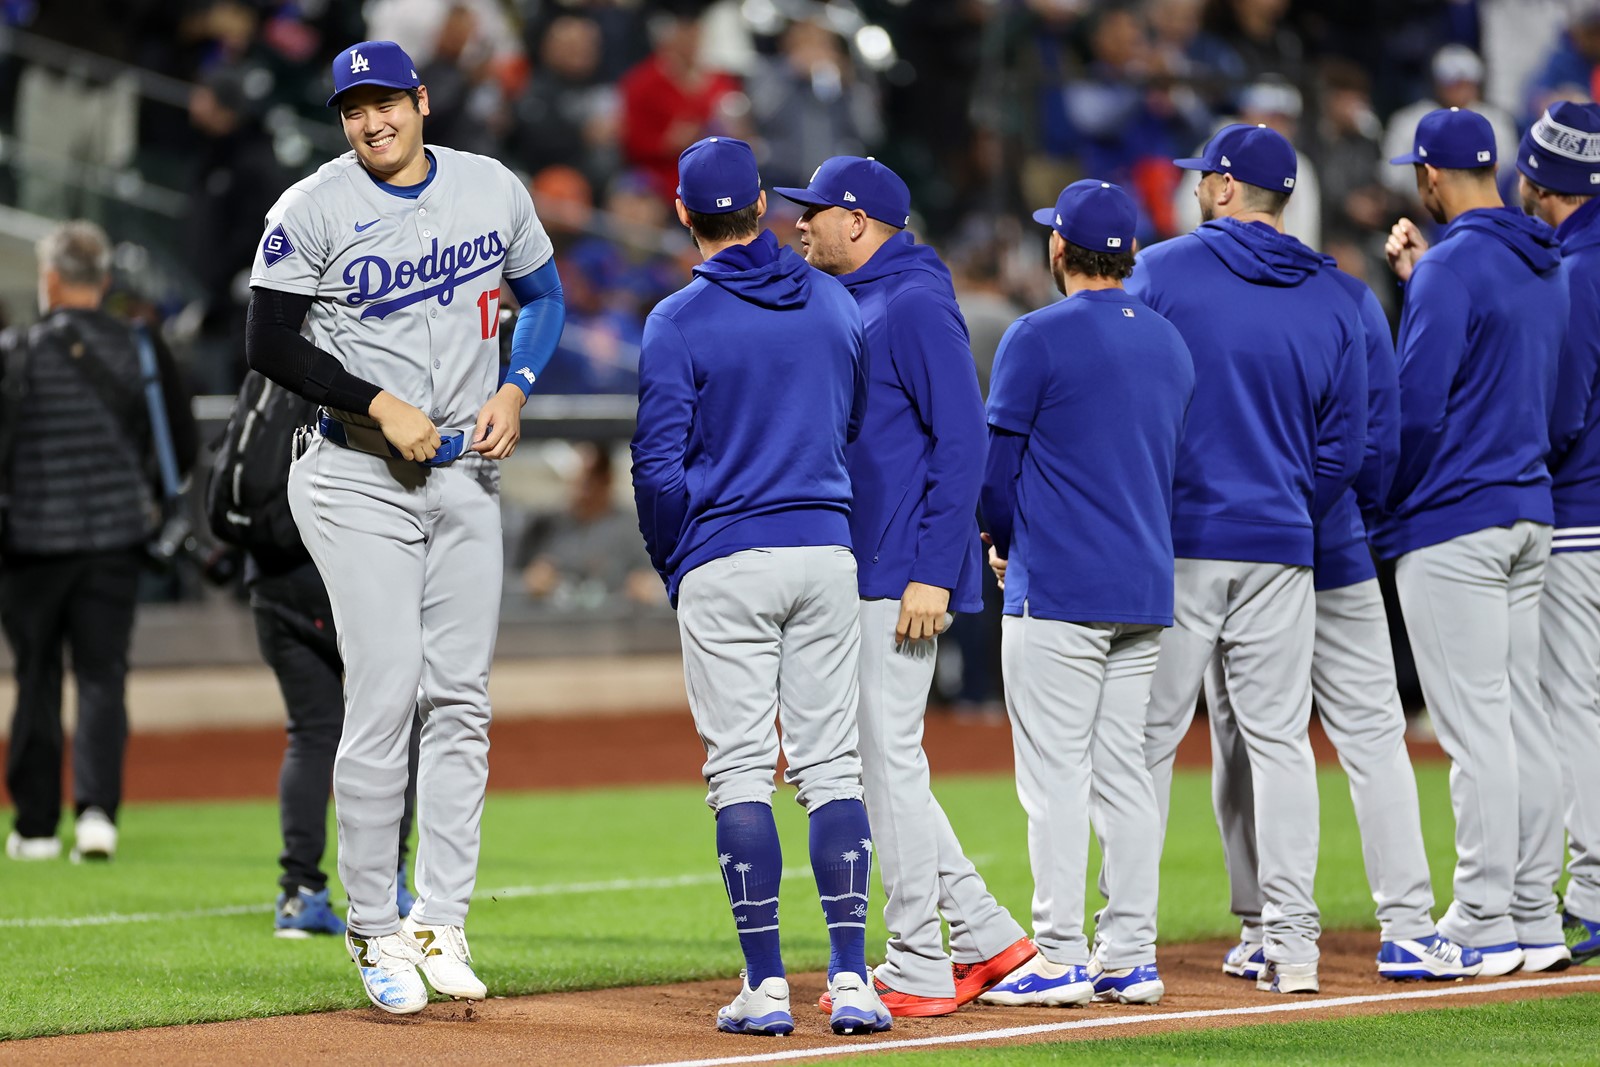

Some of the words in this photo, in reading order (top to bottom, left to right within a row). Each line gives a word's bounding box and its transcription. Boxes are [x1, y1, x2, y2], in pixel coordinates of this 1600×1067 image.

[350, 49, 370, 74] LA
[268, 234, 283, 250] G
[343, 230, 506, 306] Dodgers
[477, 287, 500, 340] 17
